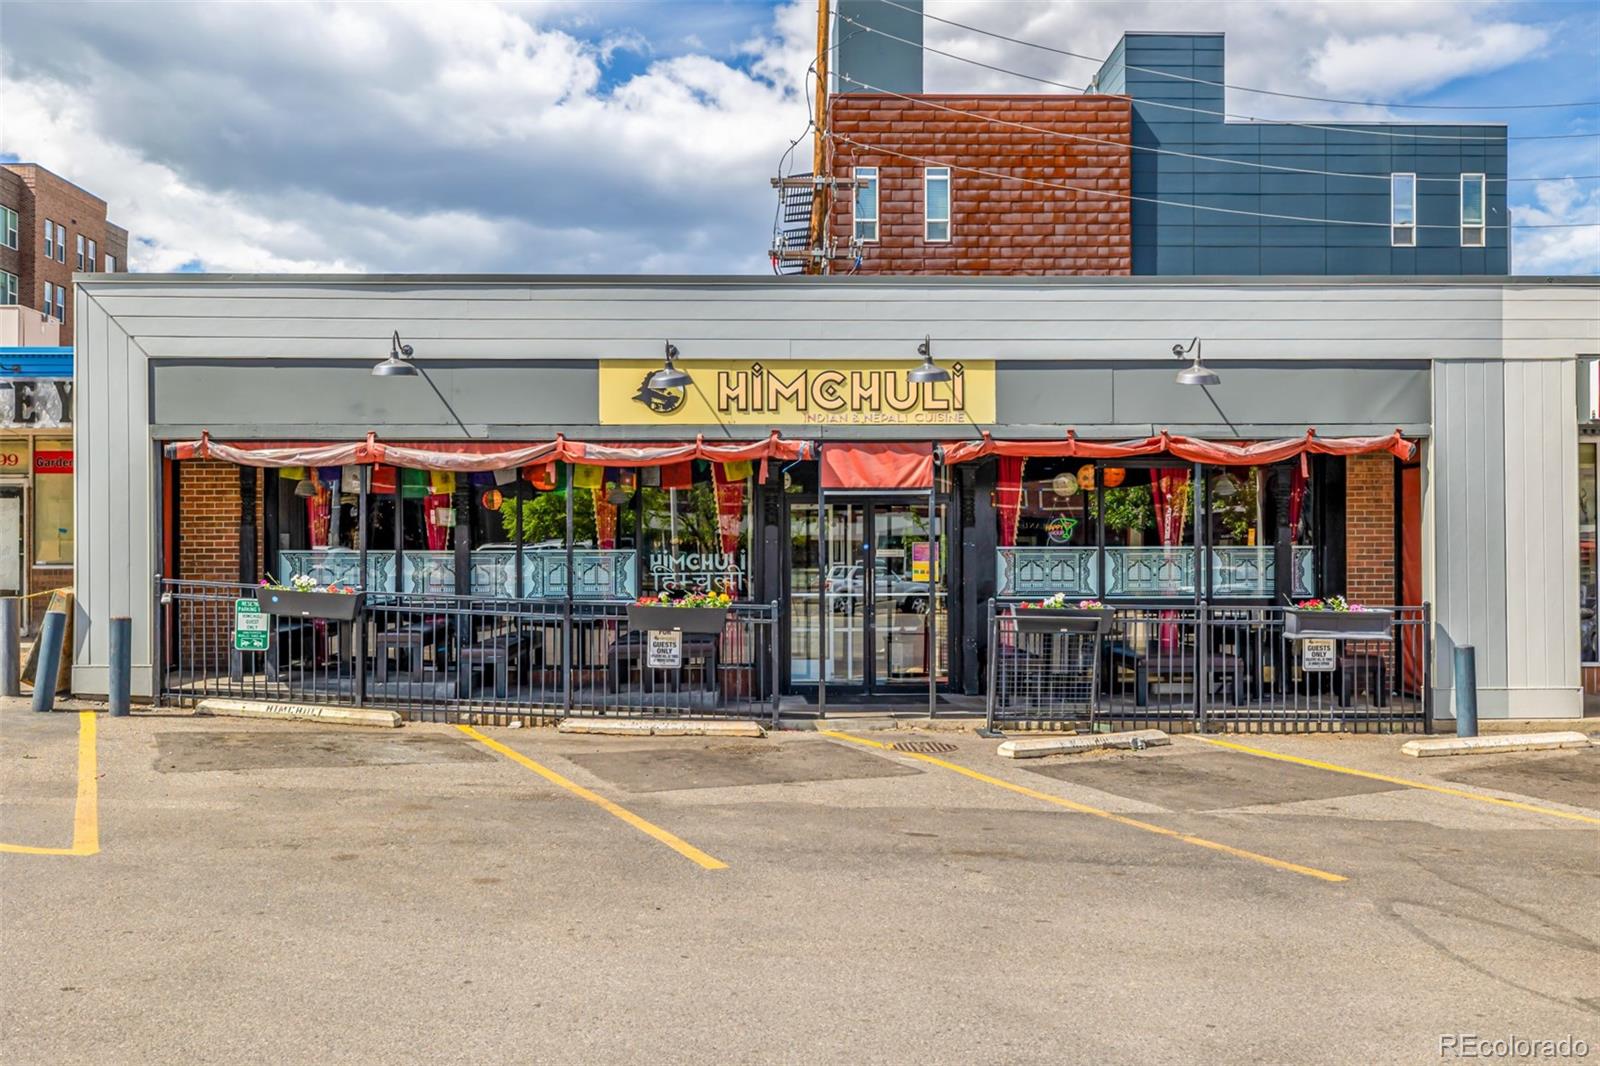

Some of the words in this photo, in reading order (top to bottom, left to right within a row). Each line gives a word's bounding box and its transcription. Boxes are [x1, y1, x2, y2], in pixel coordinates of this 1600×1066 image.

[804, 413, 848, 423] INDIAN
[852, 413, 861, 423] &
[865, 413, 909, 423] NEPALI
[914, 413, 965, 423] CUISINE
